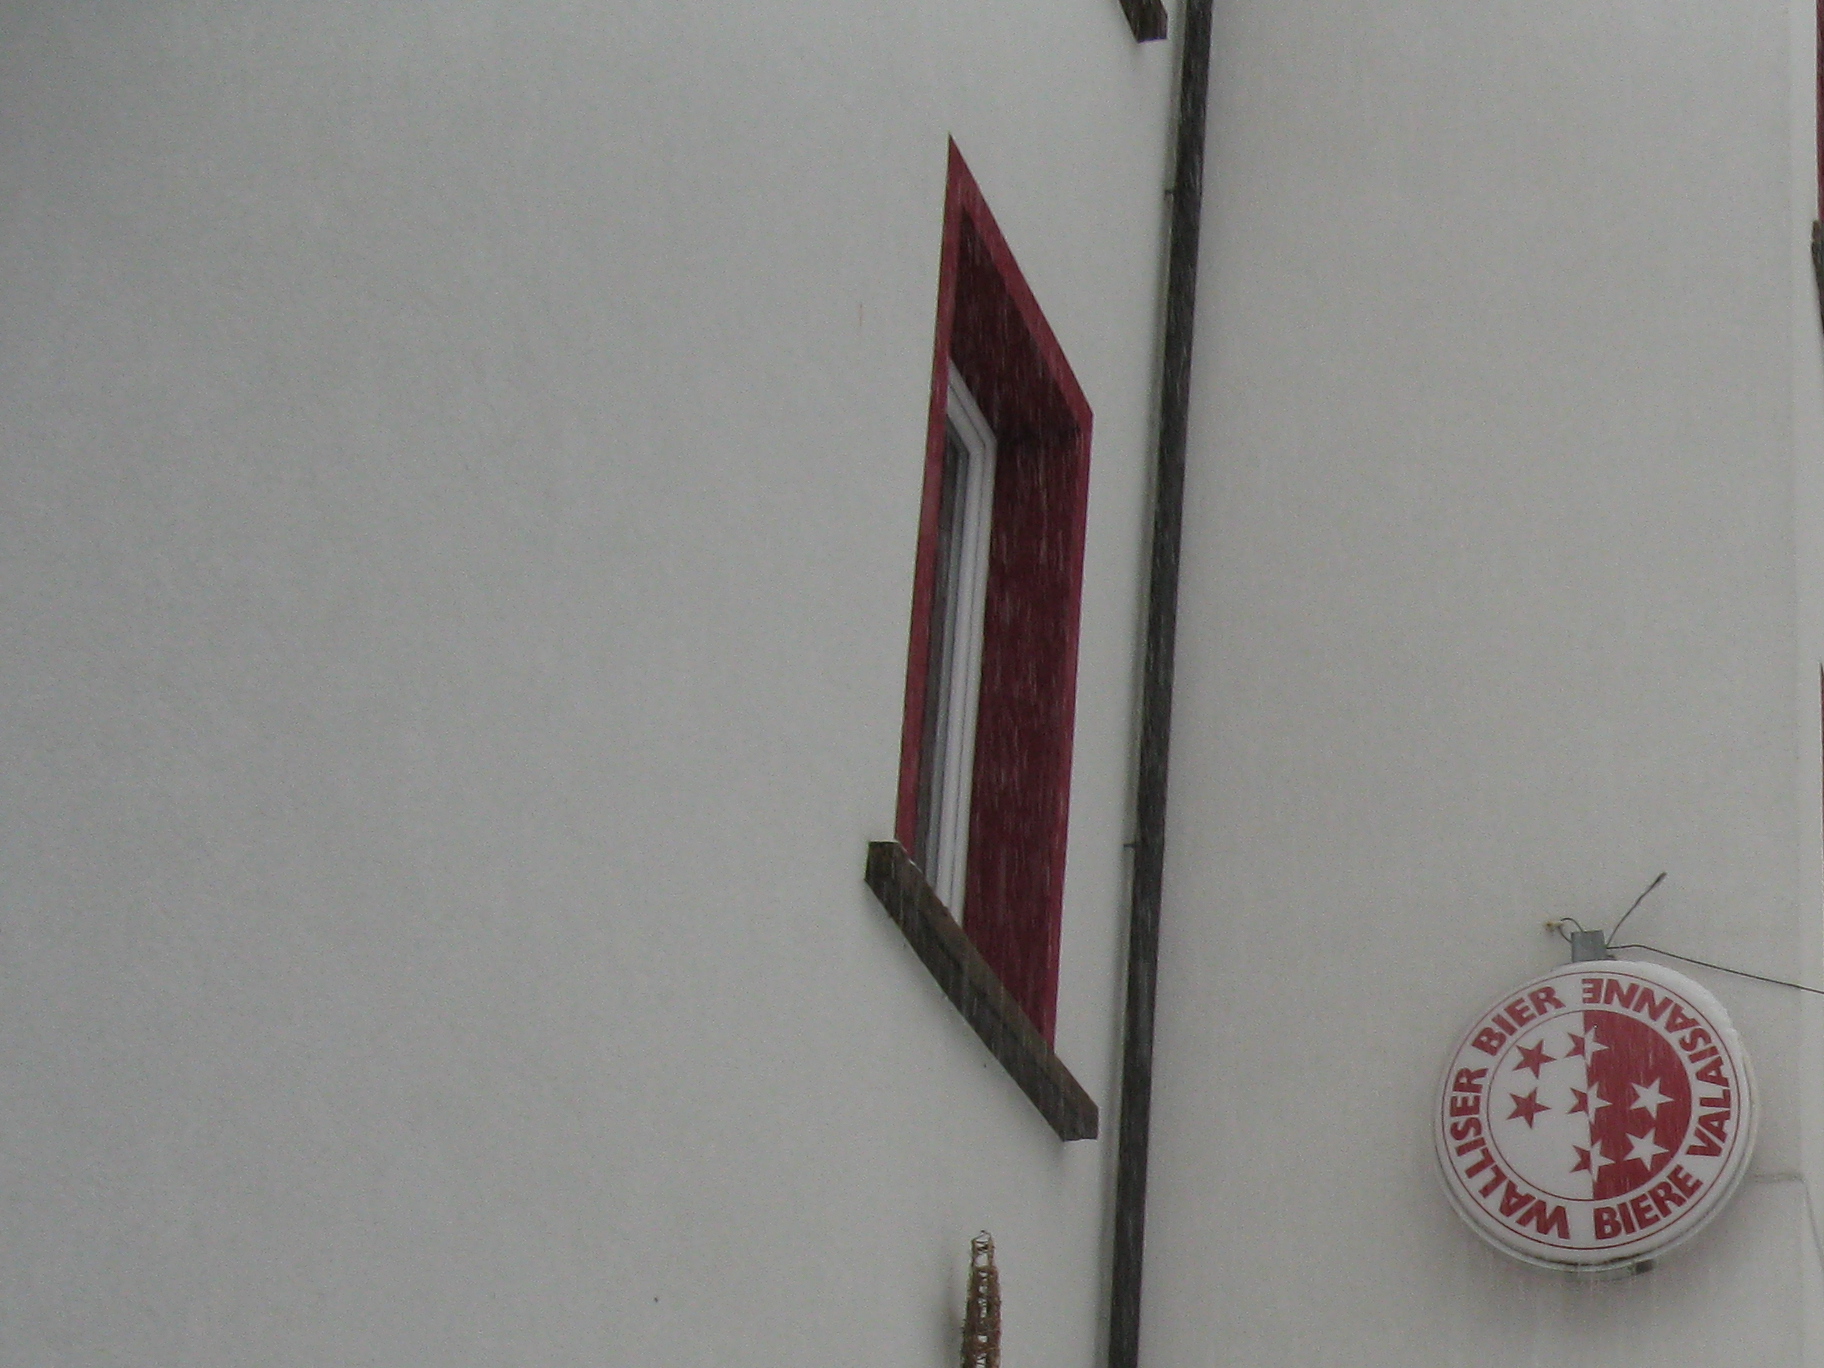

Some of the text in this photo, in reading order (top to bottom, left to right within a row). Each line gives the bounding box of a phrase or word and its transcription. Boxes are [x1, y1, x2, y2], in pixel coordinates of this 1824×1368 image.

[1451, 986, 1571, 1240] WALLISER BIER
[1581, 978, 1732, 1240] BIERE VALAISANNE
